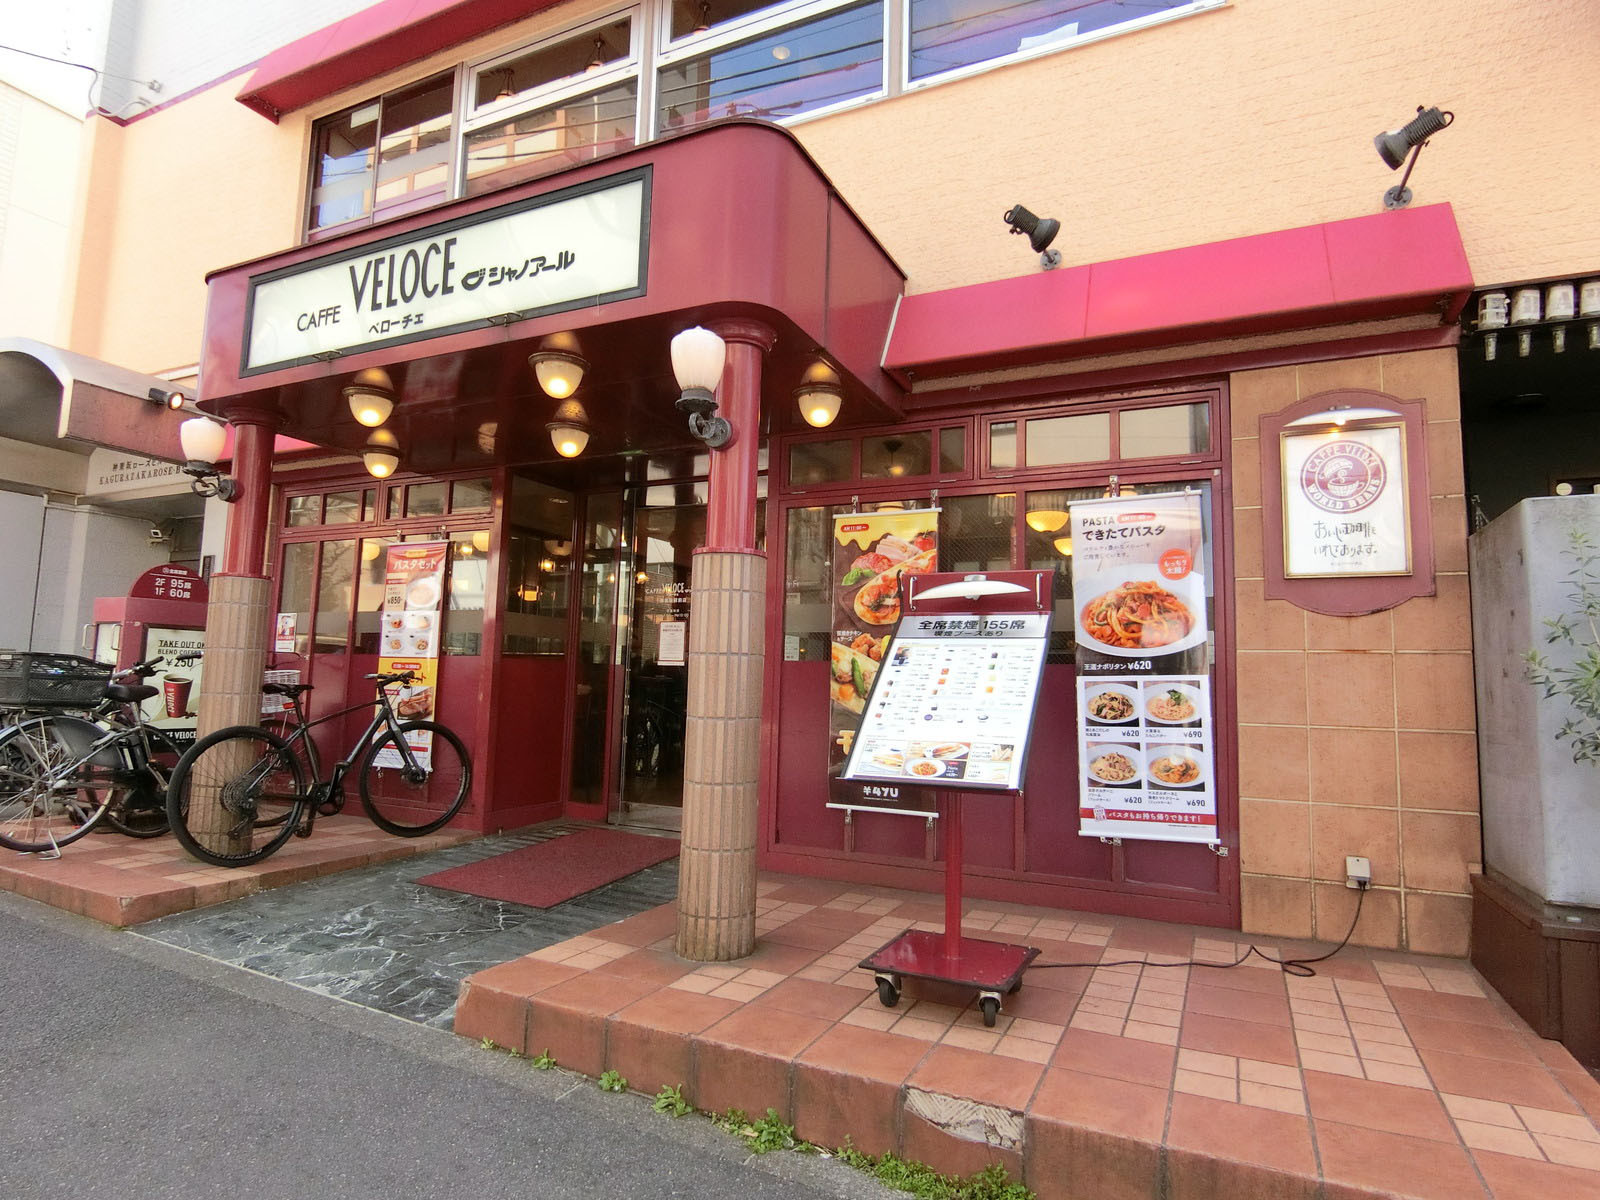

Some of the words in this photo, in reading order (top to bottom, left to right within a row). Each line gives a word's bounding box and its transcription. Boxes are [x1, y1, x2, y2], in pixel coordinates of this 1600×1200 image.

[489, 250, 576, 287] シャノアール
[297, 305, 341, 332] CAFFE
[349, 237, 457, 312] VELOCE
[1307, 445, 1342, 472] CAFFE
[1308, 482, 1344, 509] WORLD
[1082, 516, 1115, 527] PASTA
[1082, 524, 1166, 541] できたてパスタ
[393, 558, 436, 571] パスタセット
[155, 578, 166, 586] 2F
[155, 587, 166, 596] 1F
[917, 620, 979, 630] 全席禁煙
[982, 619, 1026, 630] 155席
[159, 640, 179, 648] TAKE
[181, 641, 196, 649] OUT
[1127, 660, 1152, 671] ¥620
[174, 731, 197, 740] VELOCE
[1186, 799, 1206, 807] ¥690
